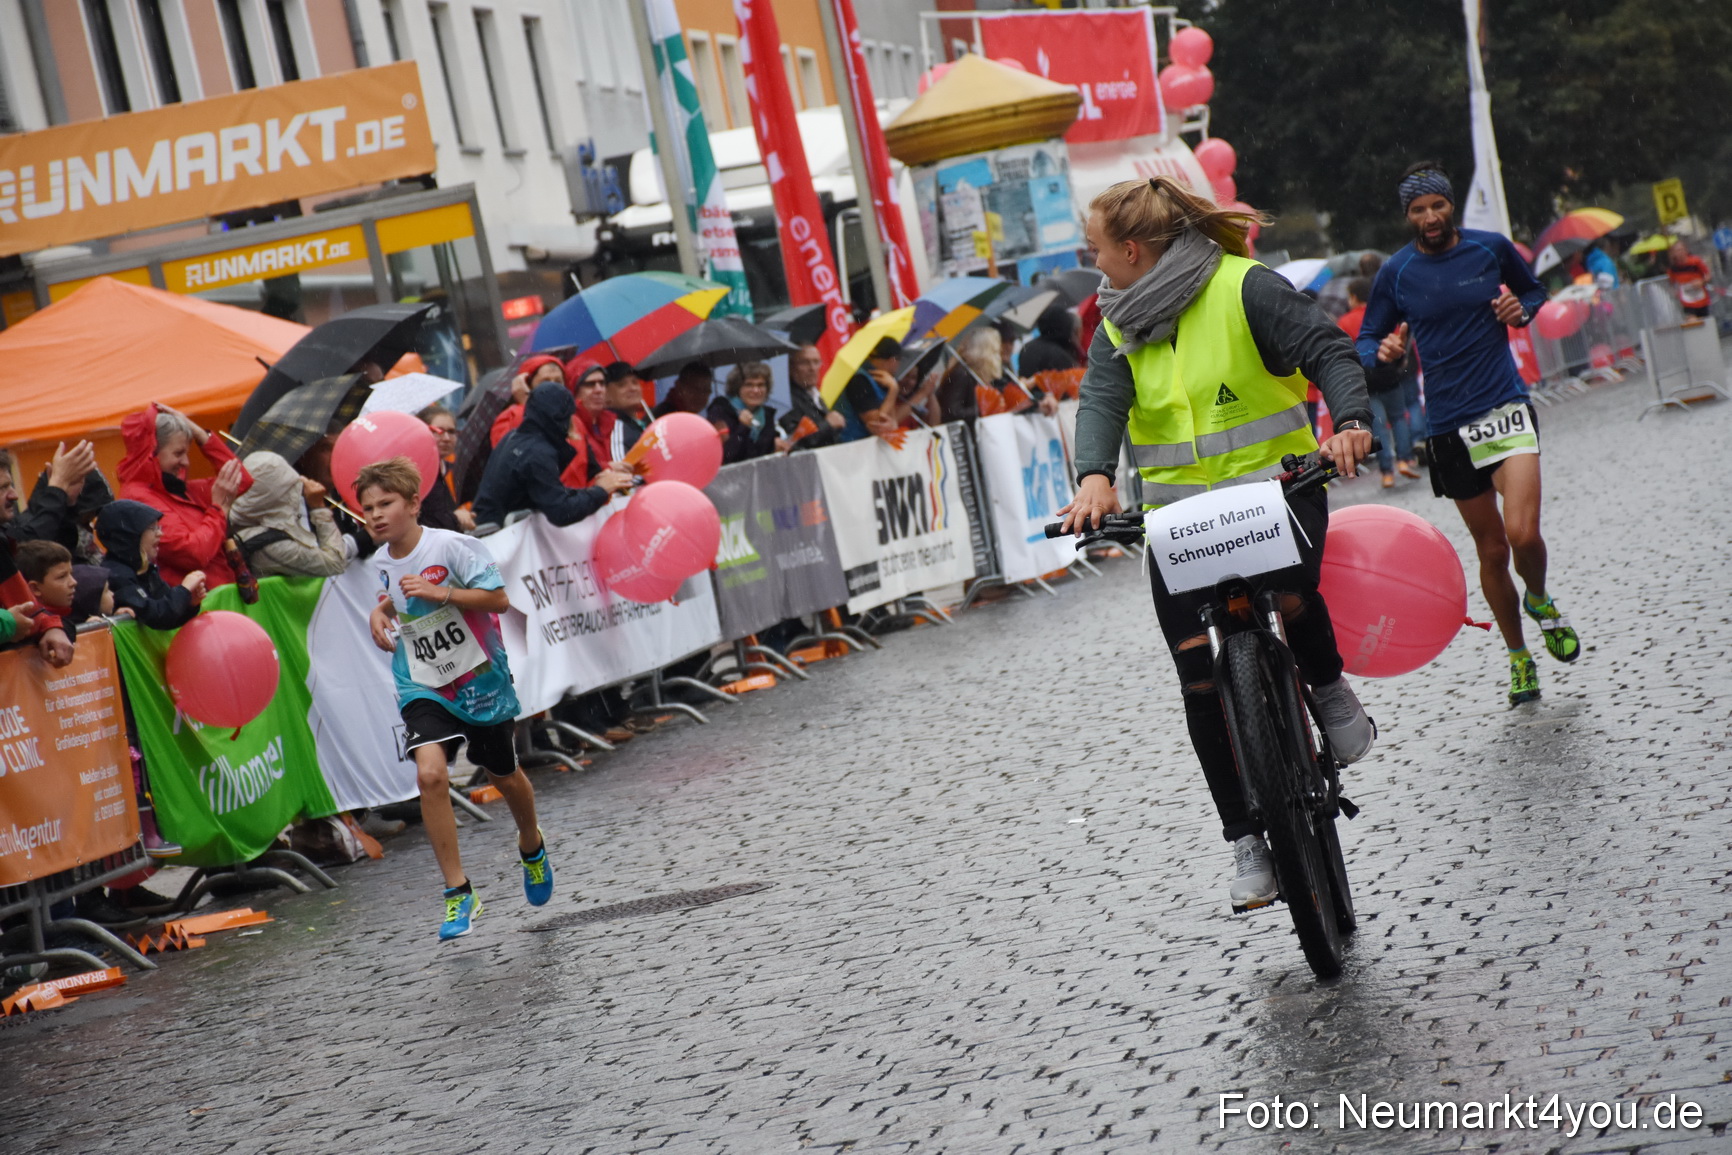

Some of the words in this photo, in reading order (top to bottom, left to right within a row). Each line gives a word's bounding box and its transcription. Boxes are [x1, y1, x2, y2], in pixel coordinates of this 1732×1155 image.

[186, 238, 350, 287] RUNMARKT.DE
[1169, 518, 1215, 541] Erster
[1219, 505, 1266, 527] Mann
[1168, 523, 1281, 566] Schnupperlauf
[412, 621, 466, 663] 4046
[436, 661, 456, 676] Tim
[461, 686, 480, 698] 17.
